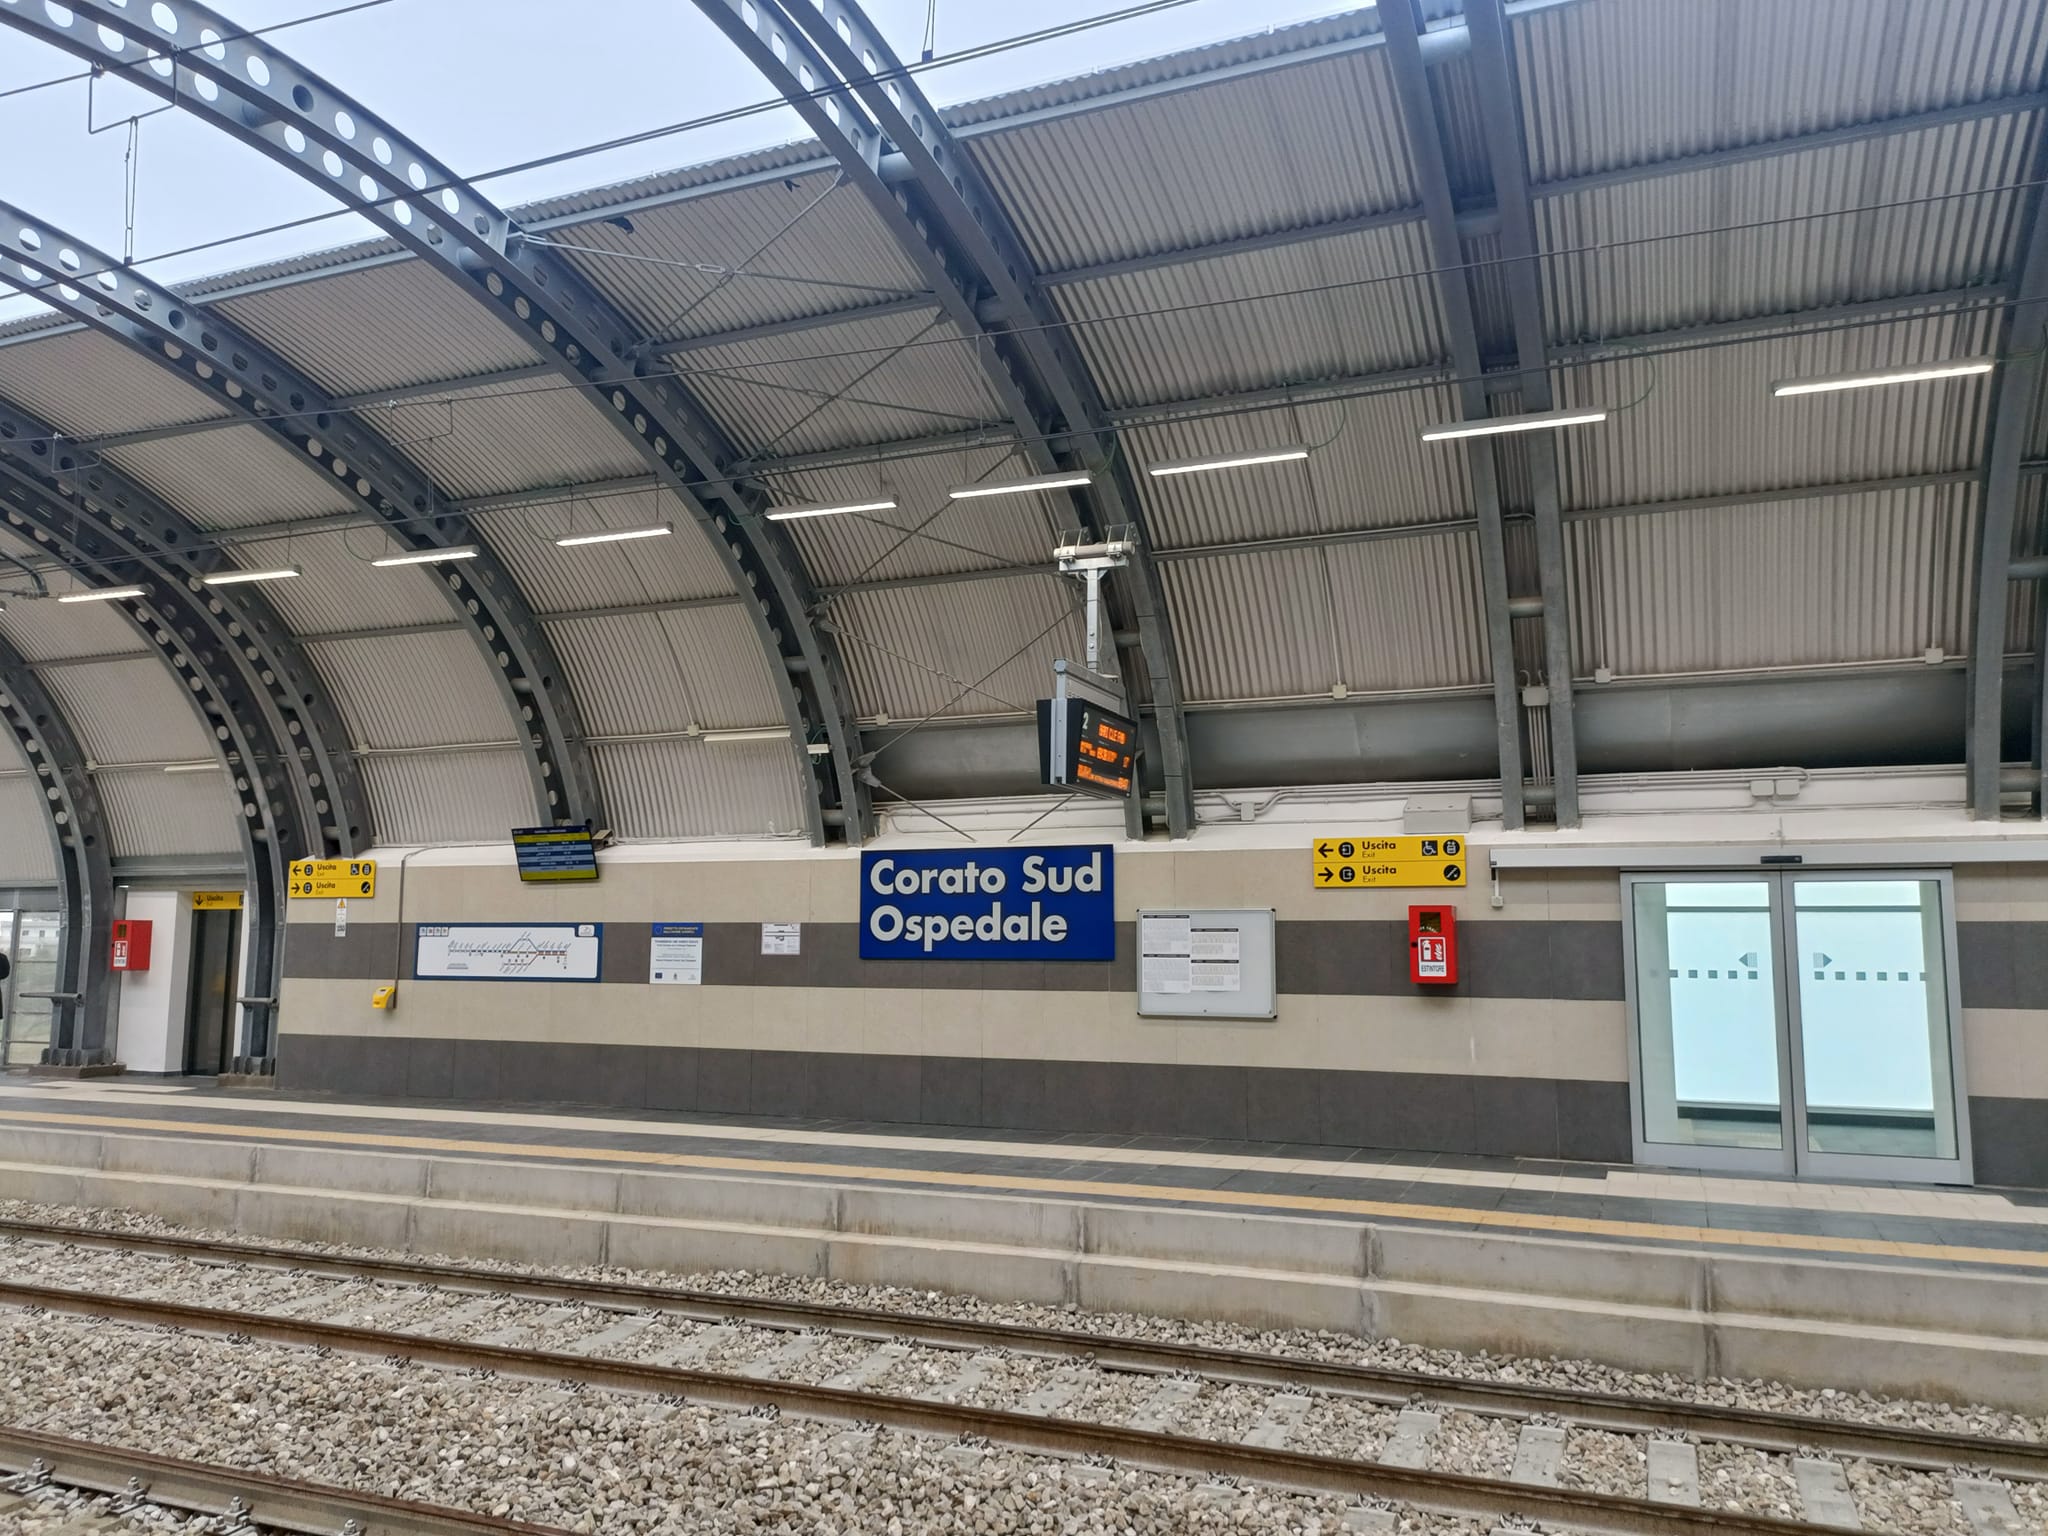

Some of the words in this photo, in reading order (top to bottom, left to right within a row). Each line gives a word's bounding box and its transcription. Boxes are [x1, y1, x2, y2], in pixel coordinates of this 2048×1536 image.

[1081, 712, 1089, 730] 2
[1362, 841, 1397, 851] Uscita
[317, 863, 337, 871] Uscita
[1362, 865, 1397, 875] Uscita
[870, 859, 1006, 895] Corato
[1022, 851, 1102, 893] Sud
[1362, 875, 1376, 883] Exit
[316, 881, 336, 889] Uscita
[870, 901, 1067, 952] Ospedale
